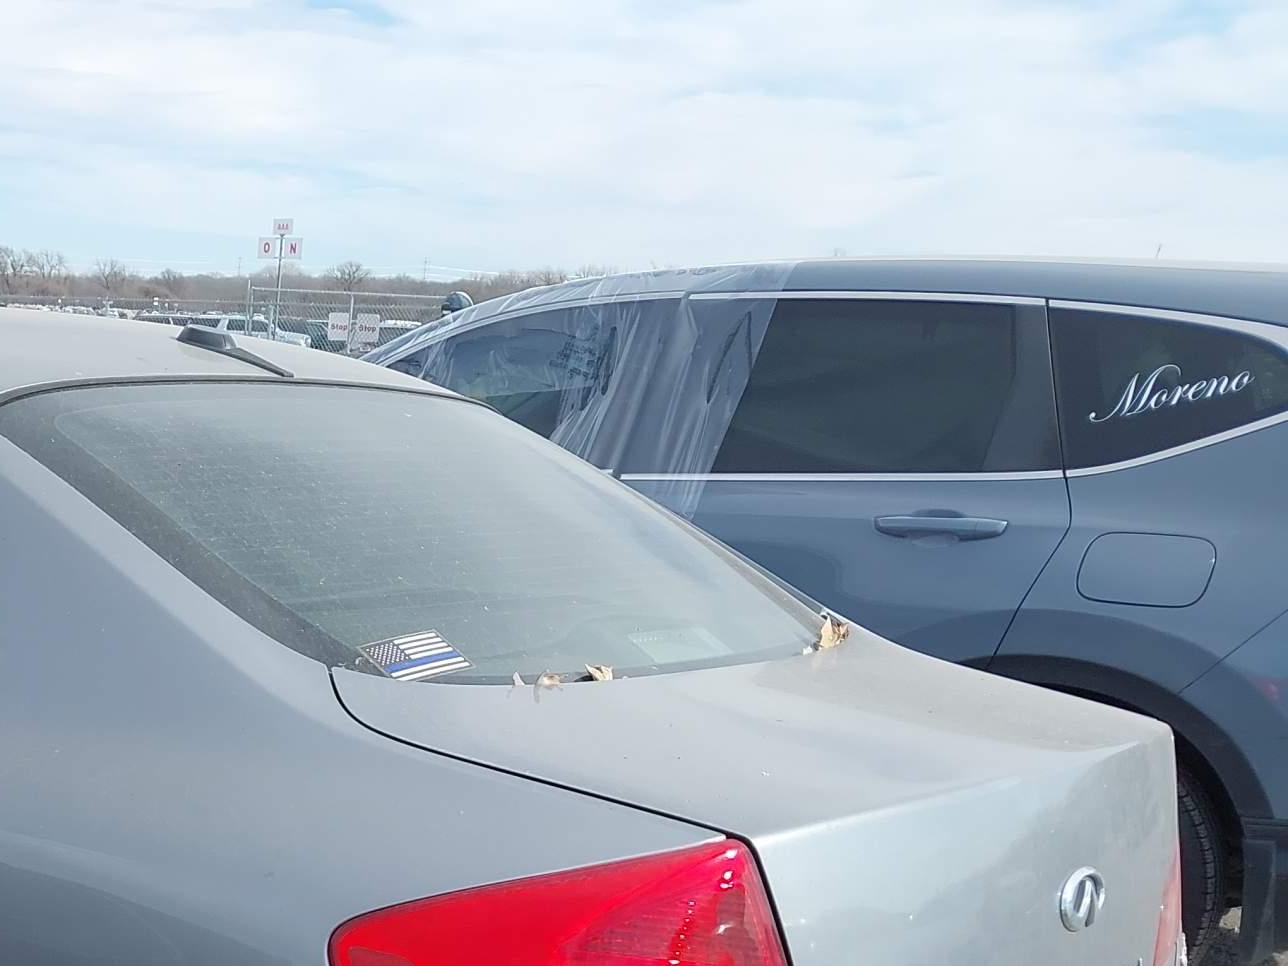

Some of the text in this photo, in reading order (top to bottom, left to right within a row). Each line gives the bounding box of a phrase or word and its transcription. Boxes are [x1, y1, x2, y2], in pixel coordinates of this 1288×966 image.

[289, 242, 297, 255] N
[330, 323, 348, 332] Stop
[1088, 364, 1256, 422] Moreno
